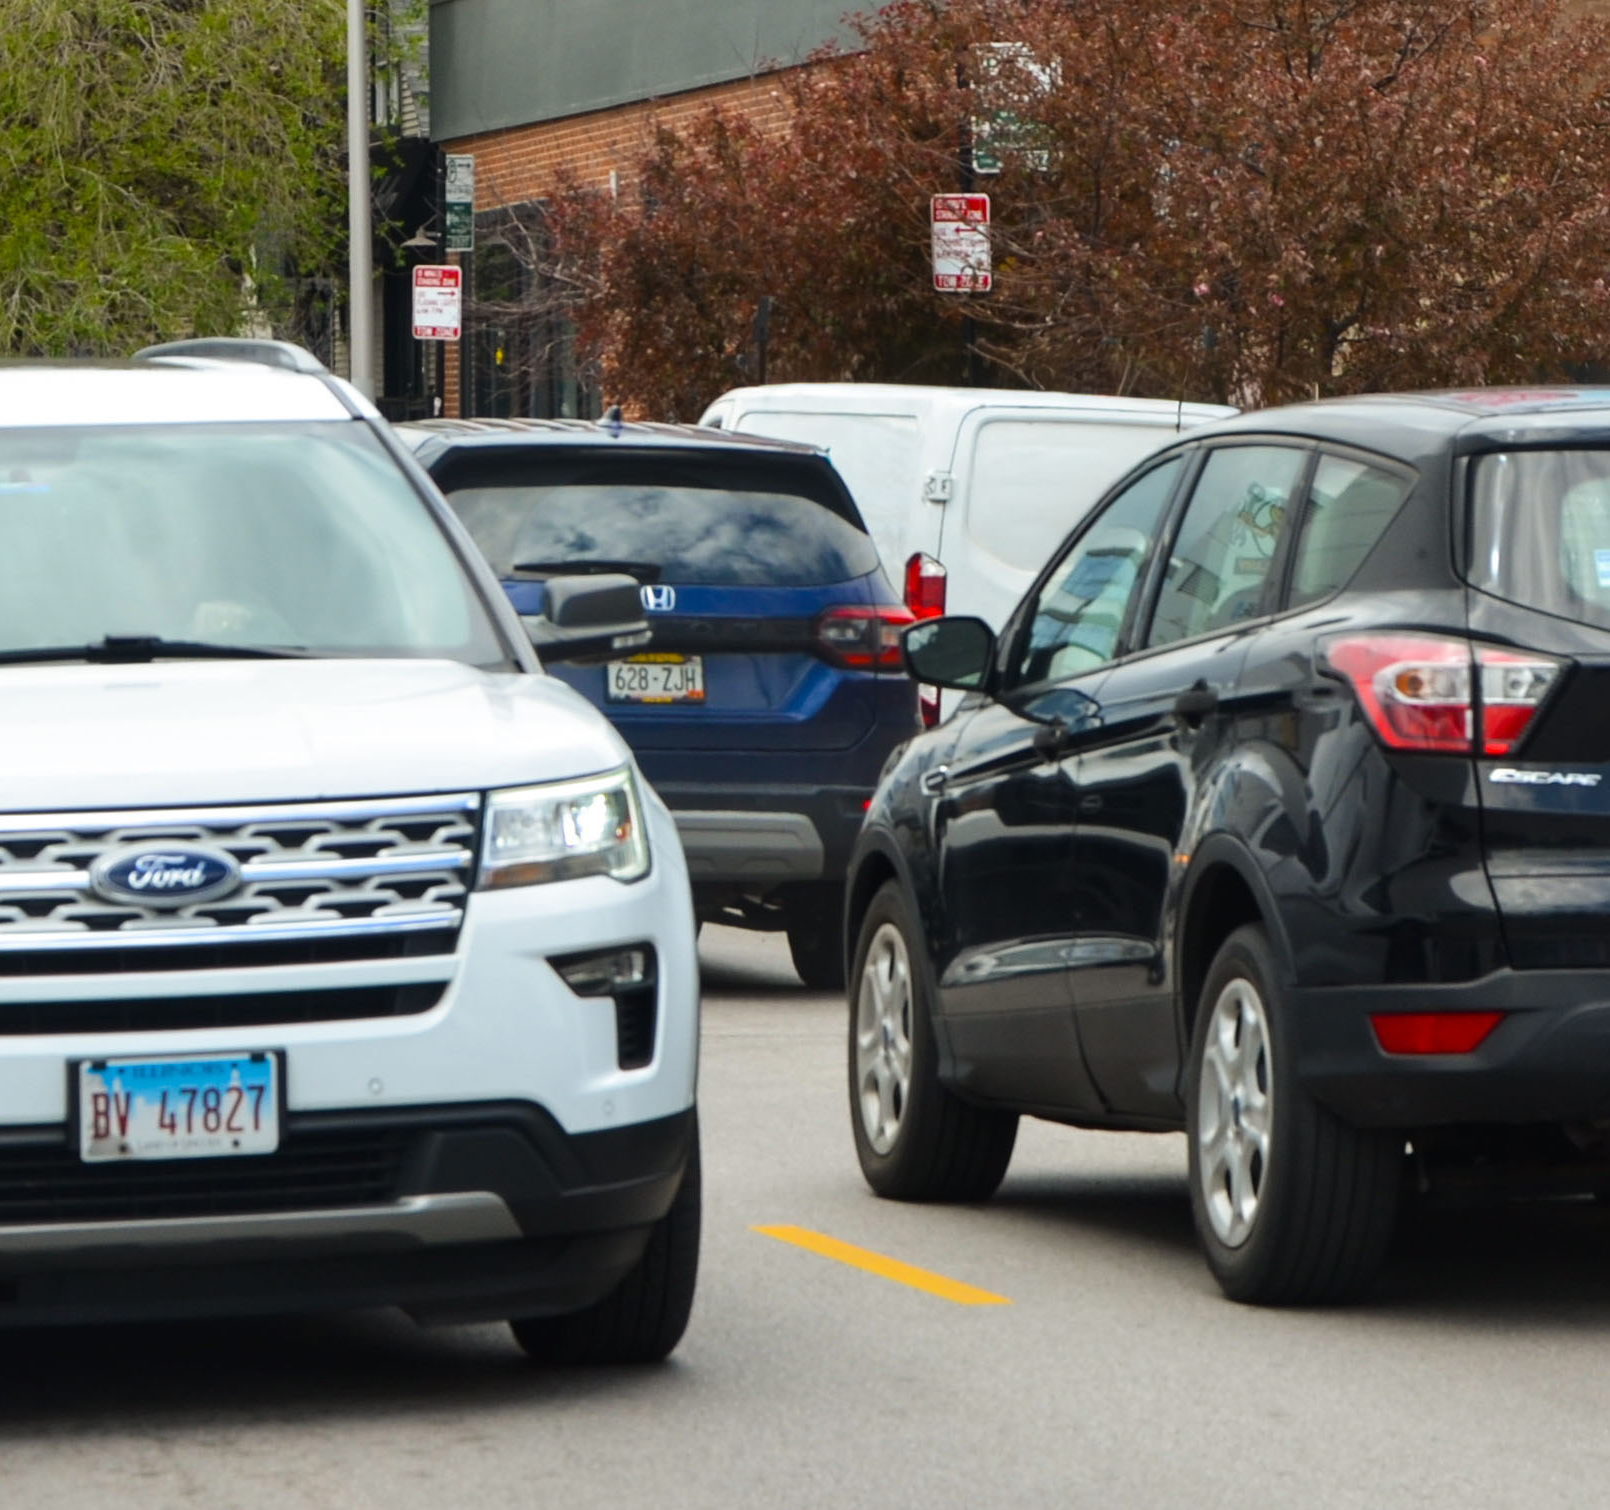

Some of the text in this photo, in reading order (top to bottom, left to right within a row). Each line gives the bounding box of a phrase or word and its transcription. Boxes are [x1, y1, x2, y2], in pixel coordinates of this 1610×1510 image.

[615, 667, 695, 691] 628-ZJH
[128, 855, 206, 889] Ford
[92, 1085, 265, 1140] BV 47827
